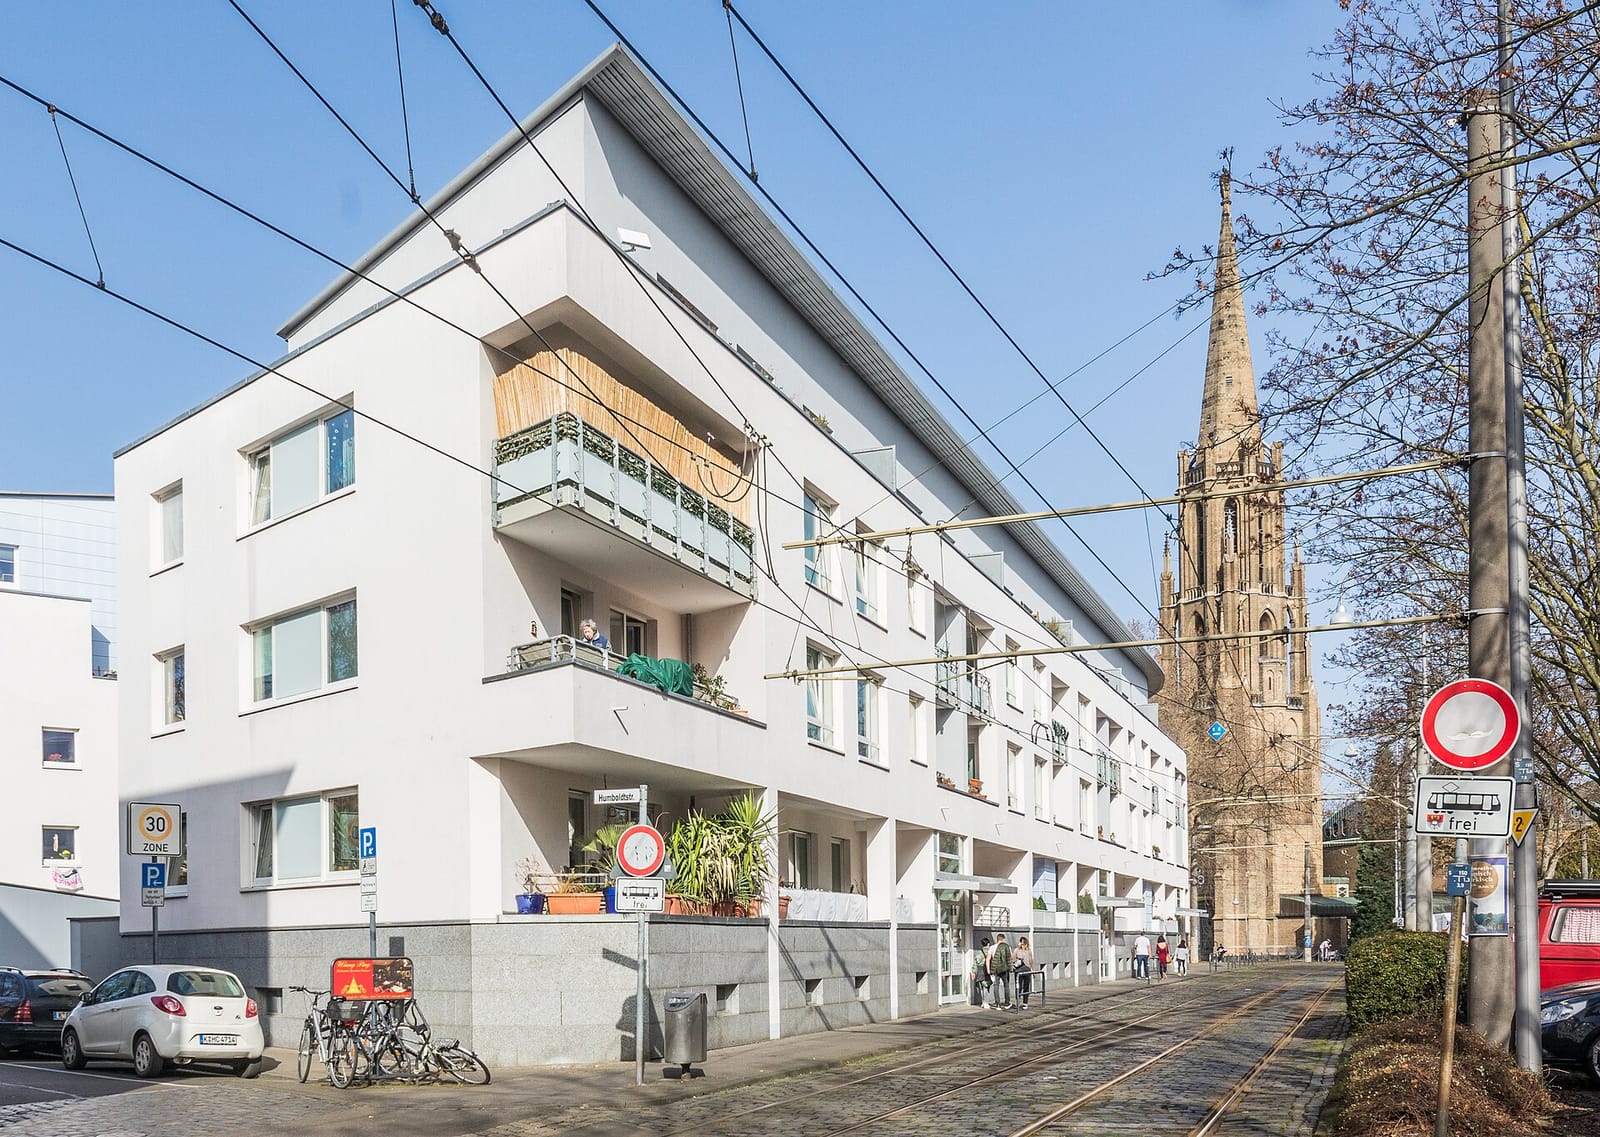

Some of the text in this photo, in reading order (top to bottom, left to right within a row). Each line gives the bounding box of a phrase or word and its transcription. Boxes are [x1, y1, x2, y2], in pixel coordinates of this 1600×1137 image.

[598, 793, 635, 802] Humboldtstr.
[145, 816, 166, 832] 30
[1449, 817, 1477, 831] frei
[1515, 817, 1523, 832] 2
[143, 842, 169, 852] ZONE
